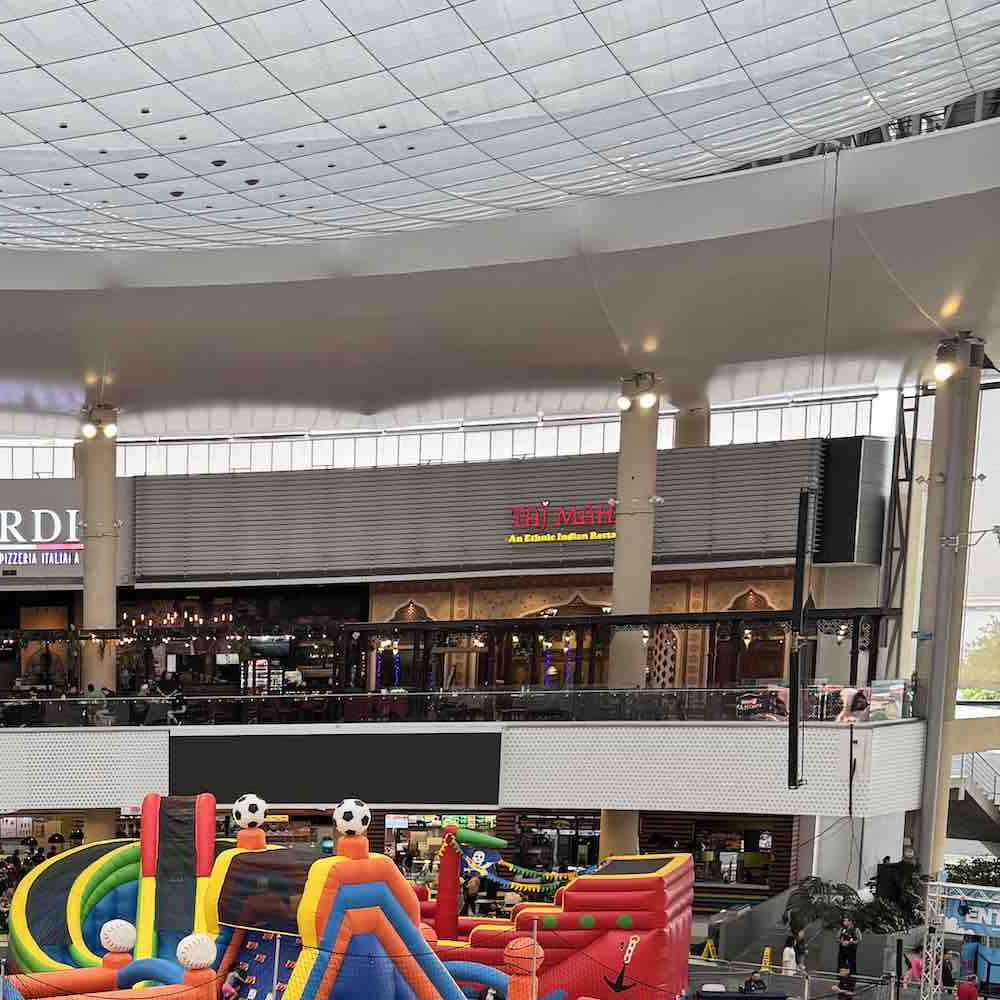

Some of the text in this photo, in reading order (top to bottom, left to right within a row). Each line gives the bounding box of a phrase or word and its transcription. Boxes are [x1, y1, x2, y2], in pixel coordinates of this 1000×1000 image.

[508, 533, 523, 543] An
[524, 533, 556, 543] Ethnic
[557, 532, 589, 542] Indian
[0, 552, 37, 565] PIZZERIA
